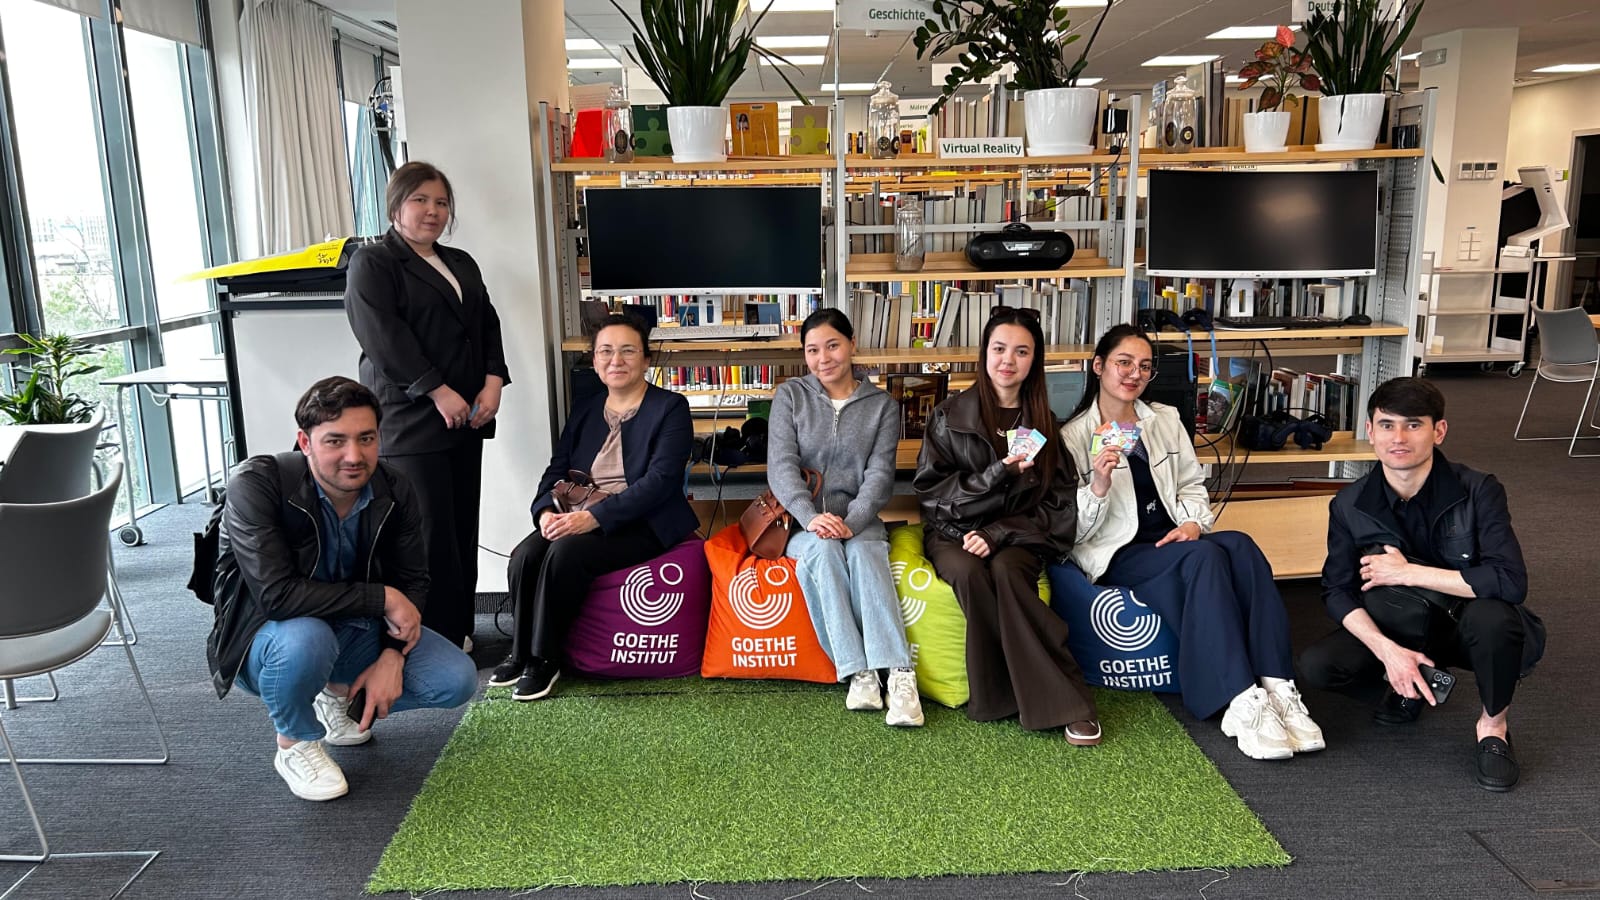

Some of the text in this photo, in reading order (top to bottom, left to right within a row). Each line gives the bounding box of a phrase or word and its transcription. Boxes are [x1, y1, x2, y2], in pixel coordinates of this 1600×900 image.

[868, 8, 926, 21] Geschichte
[942, 143, 1021, 155] Virtual Reality
[613, 632, 679, 648] GOETHE
[731, 636, 796, 652] GOETHE
[610, 648, 677, 664] INSTITUT
[732, 653, 797, 668] INSTITUT
[1100, 655, 1170, 673] GOETHE
[1102, 672, 1172, 688] INSTITUT
